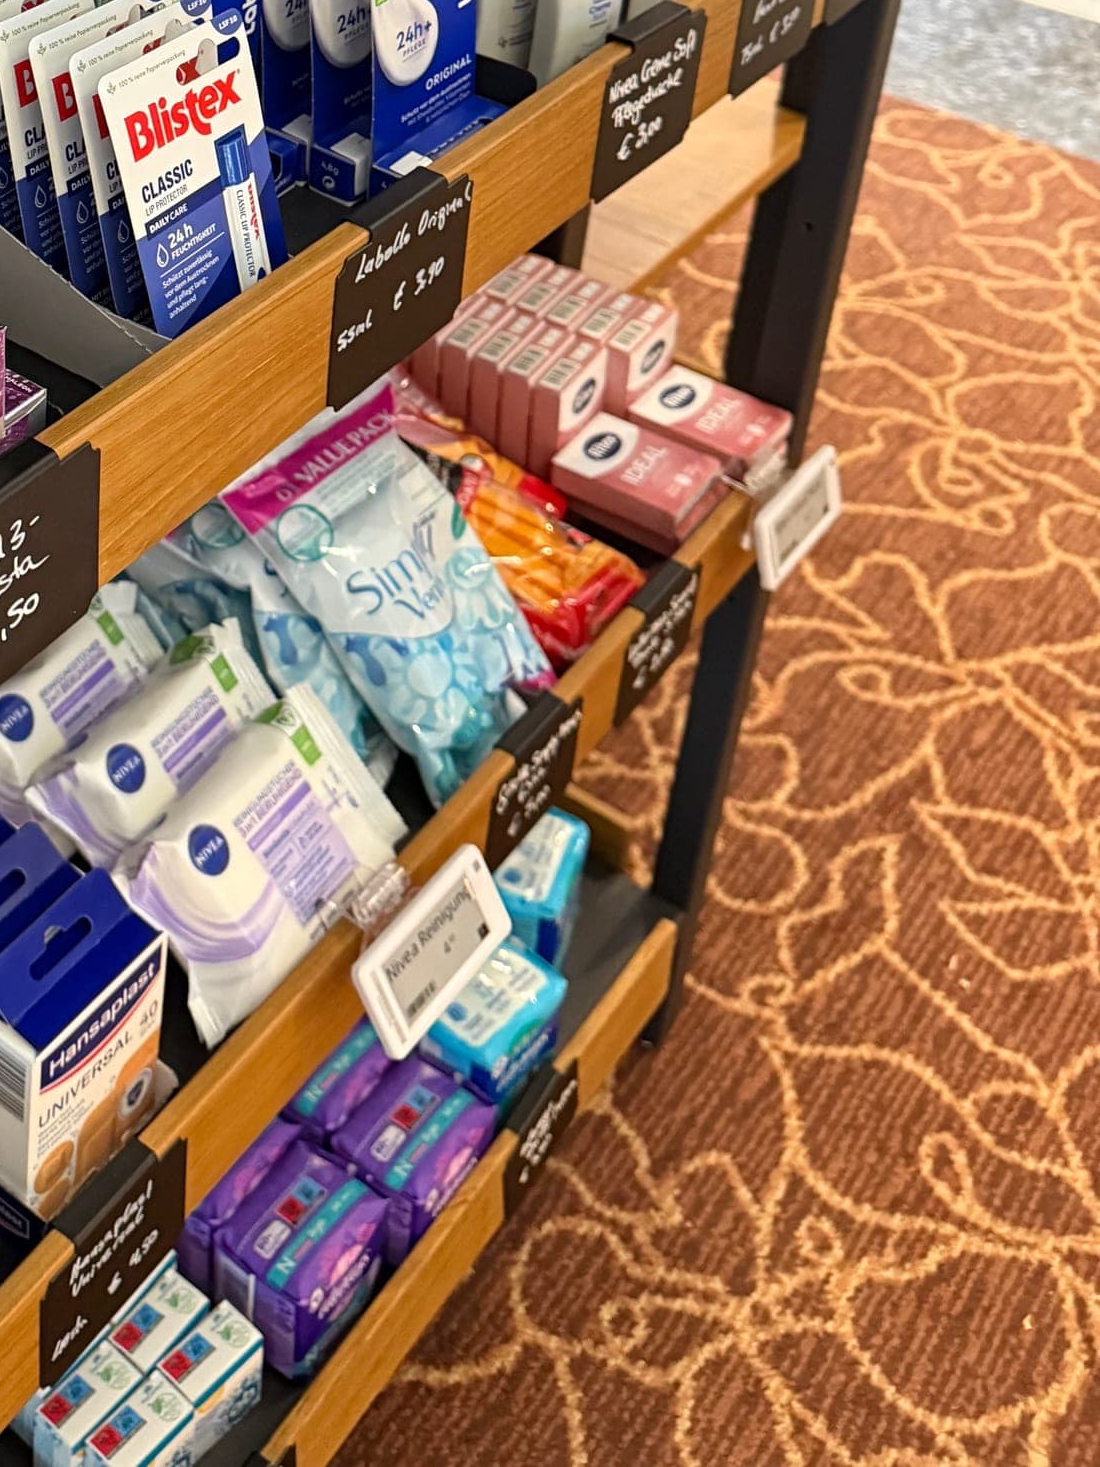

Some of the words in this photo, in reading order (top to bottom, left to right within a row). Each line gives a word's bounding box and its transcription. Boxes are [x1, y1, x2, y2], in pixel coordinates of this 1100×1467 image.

[425, 53, 472, 91] ORIGINAL
[609, 73, 640, 105] Nivea
[123, 69, 243, 163] Blistex
[141, 158, 194, 205] CLASSIC
[167, 222, 194, 248] 24h
[171, 222, 217, 260] FEUCHTIGKEIT
[294, 440, 352, 485] VALUE
[0, 704, 30, 732] NIVEA
[112, 755, 142, 783] NIVEA
[194, 835, 224, 866] NIVEA
[49, 961, 156, 1078] Hansaplast
[139, 999, 159, 1028] 40
[39, 1030, 134, 1129] UNIVERSAL
